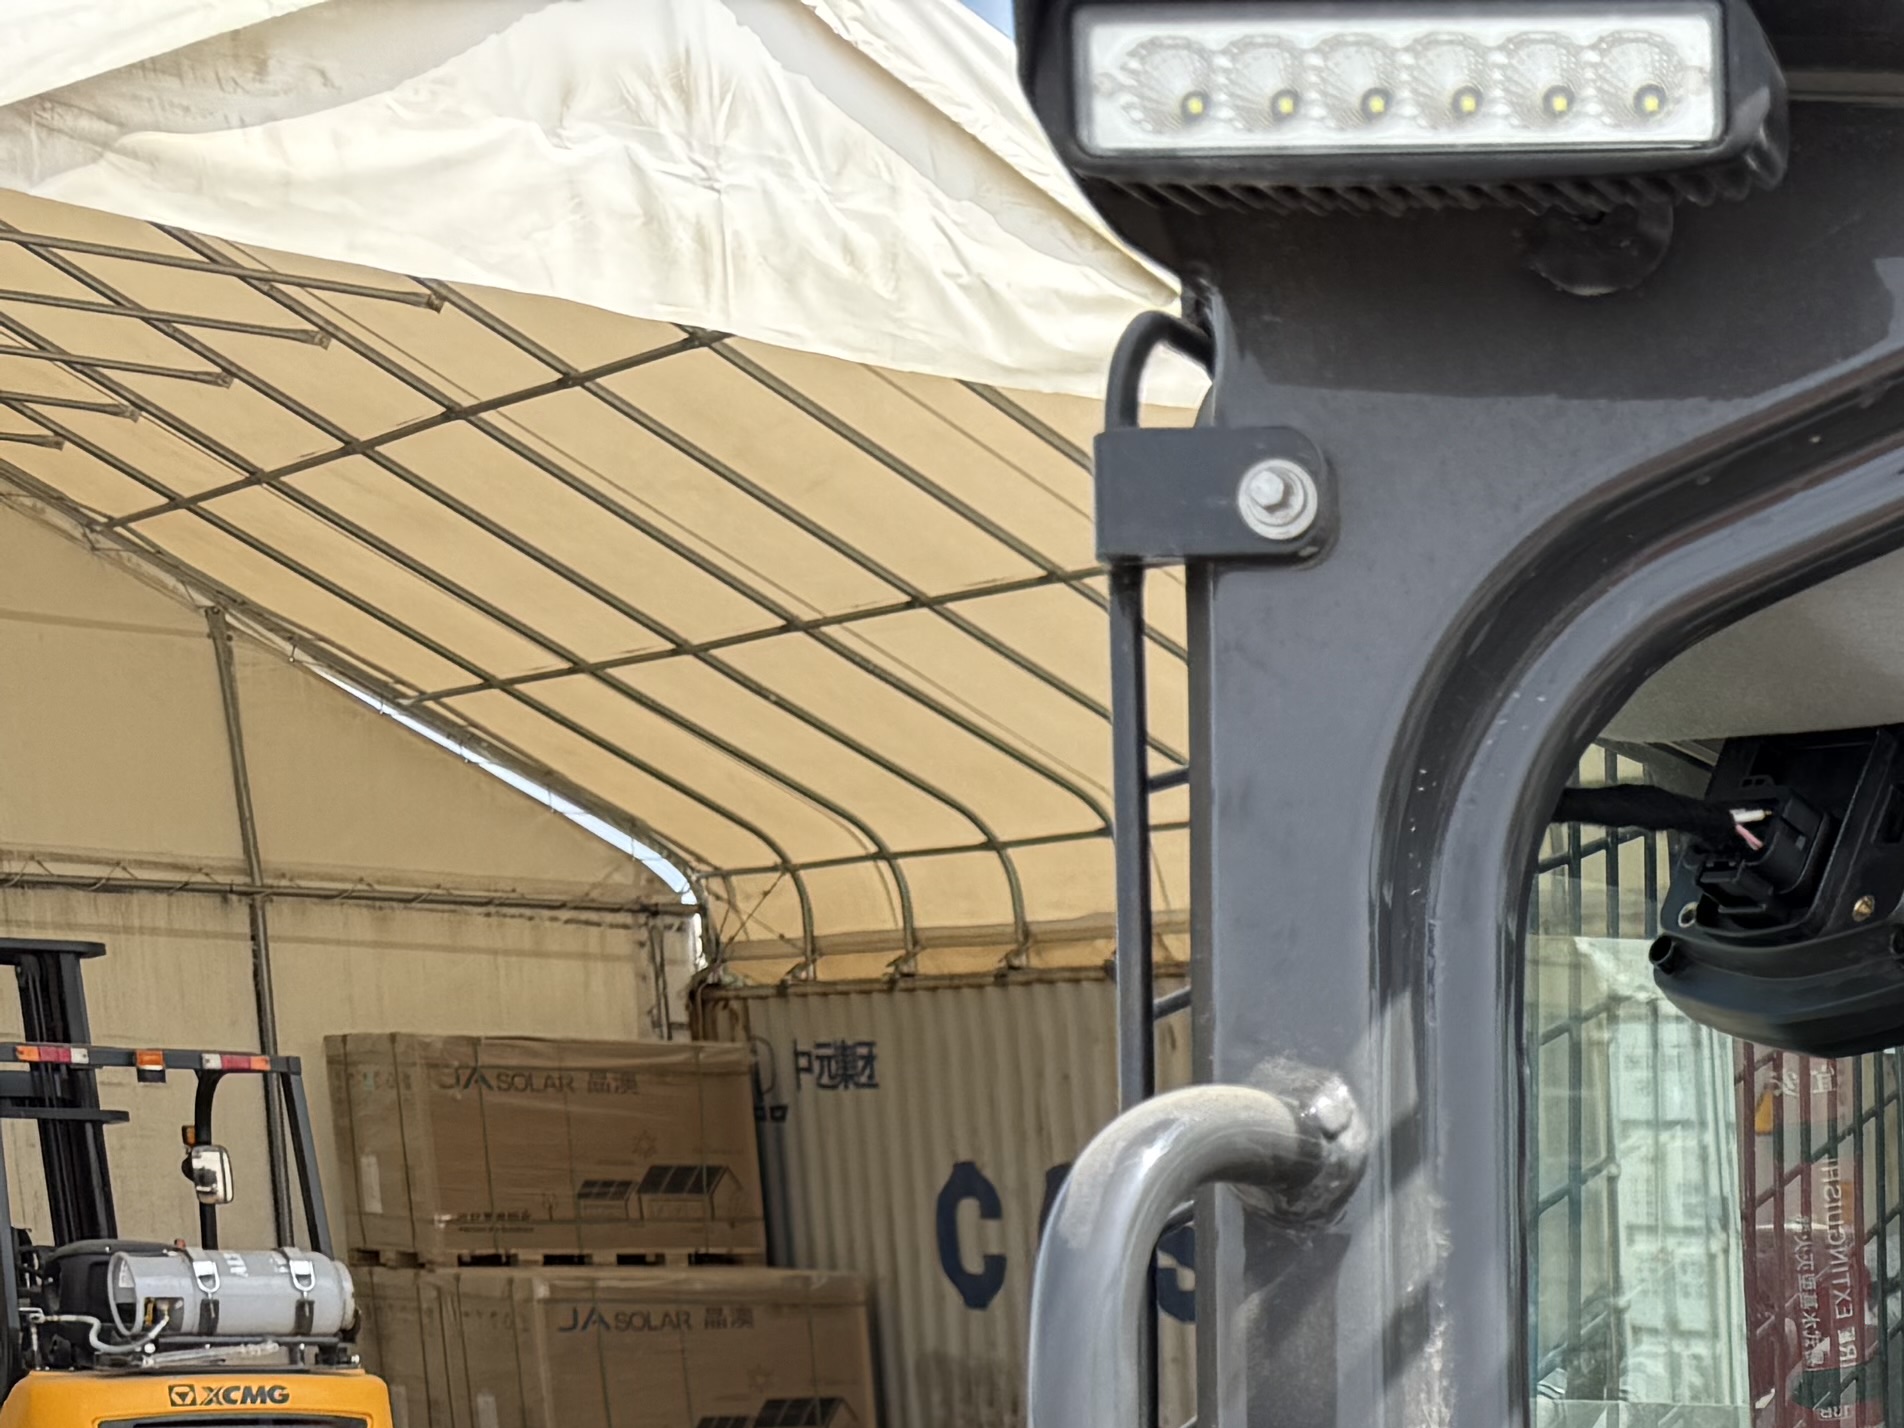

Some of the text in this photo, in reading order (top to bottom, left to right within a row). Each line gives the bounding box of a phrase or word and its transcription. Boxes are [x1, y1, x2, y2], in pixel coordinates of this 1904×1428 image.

[495, 1071, 576, 1093] SOLAR
[613, 1310, 694, 1332] SOLAR
[199, 1384, 290, 1406] XCMG
